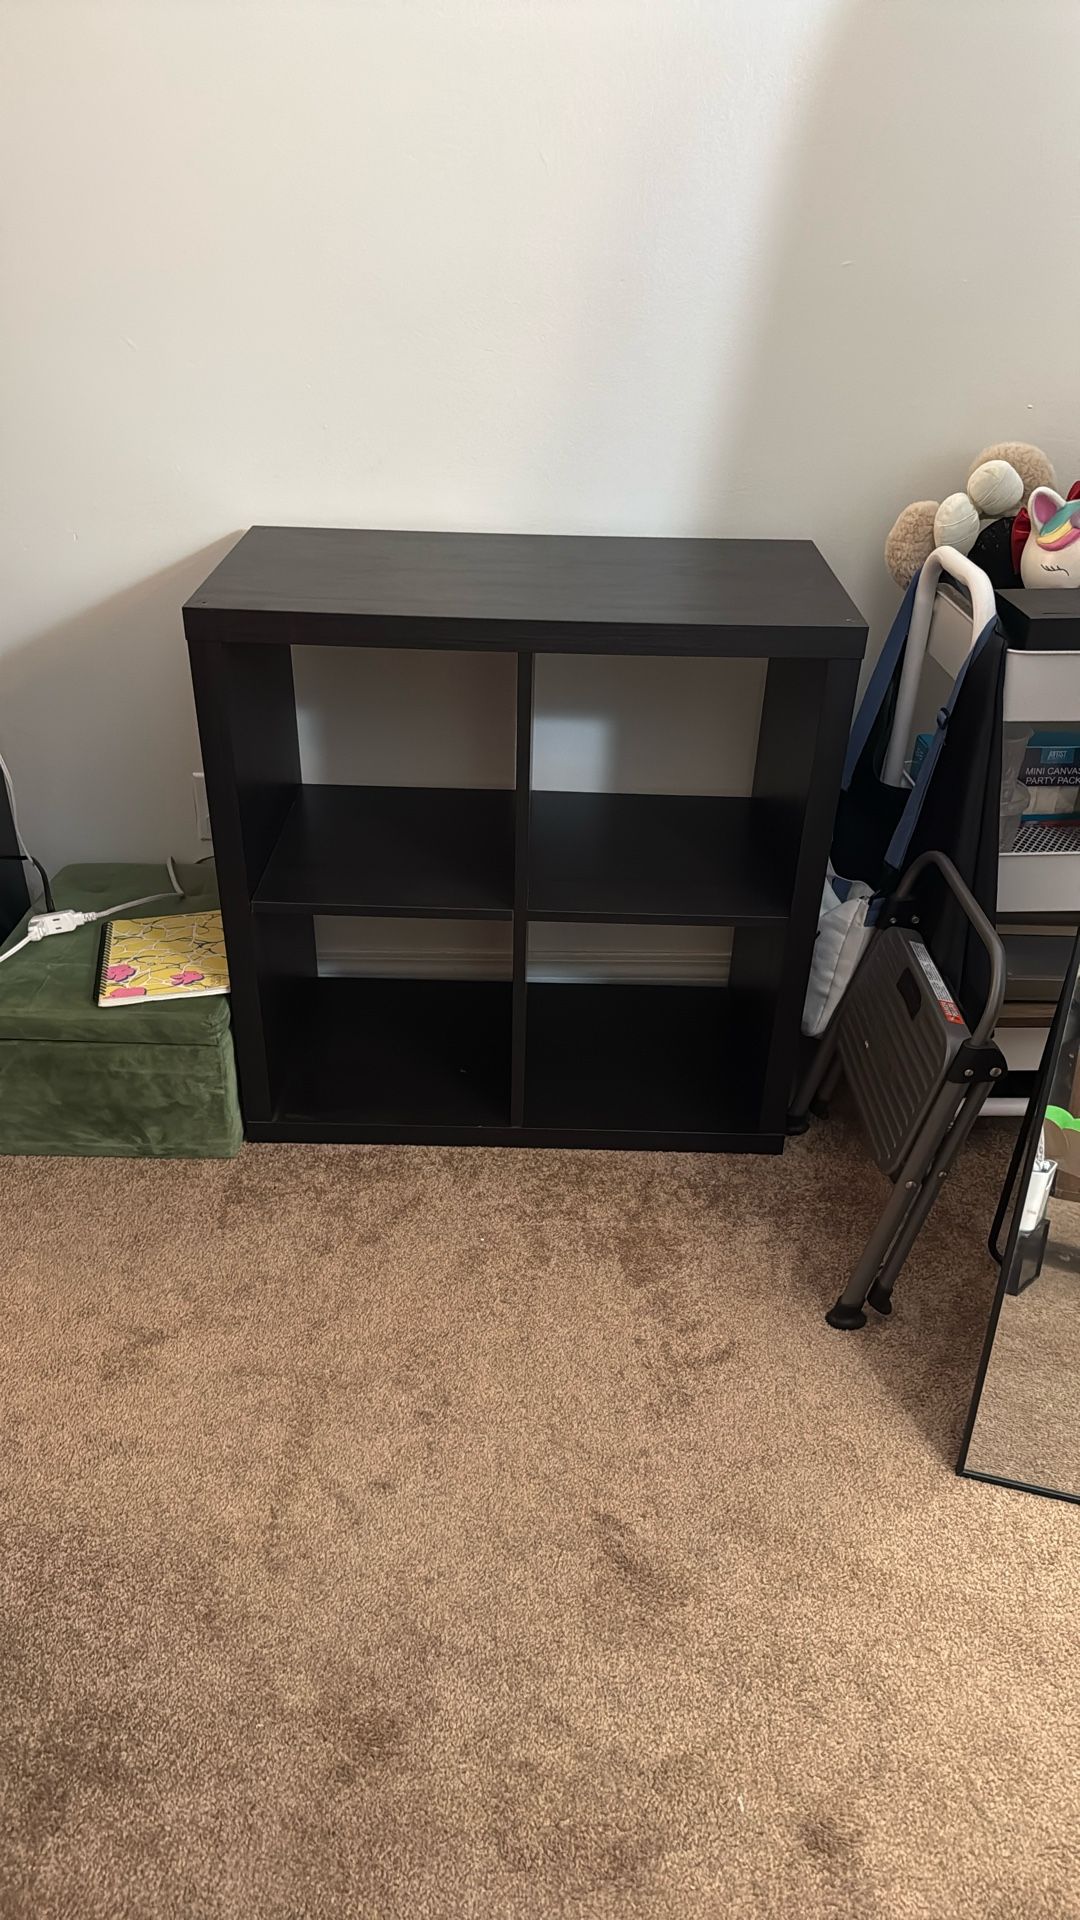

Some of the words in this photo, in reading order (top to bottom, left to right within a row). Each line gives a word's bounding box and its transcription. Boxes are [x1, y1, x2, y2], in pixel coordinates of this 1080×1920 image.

[1025, 767, 1045, 775] MINI
[1025, 776, 1056, 785] PARTY
[1057, 776, 1080, 785] PACK
